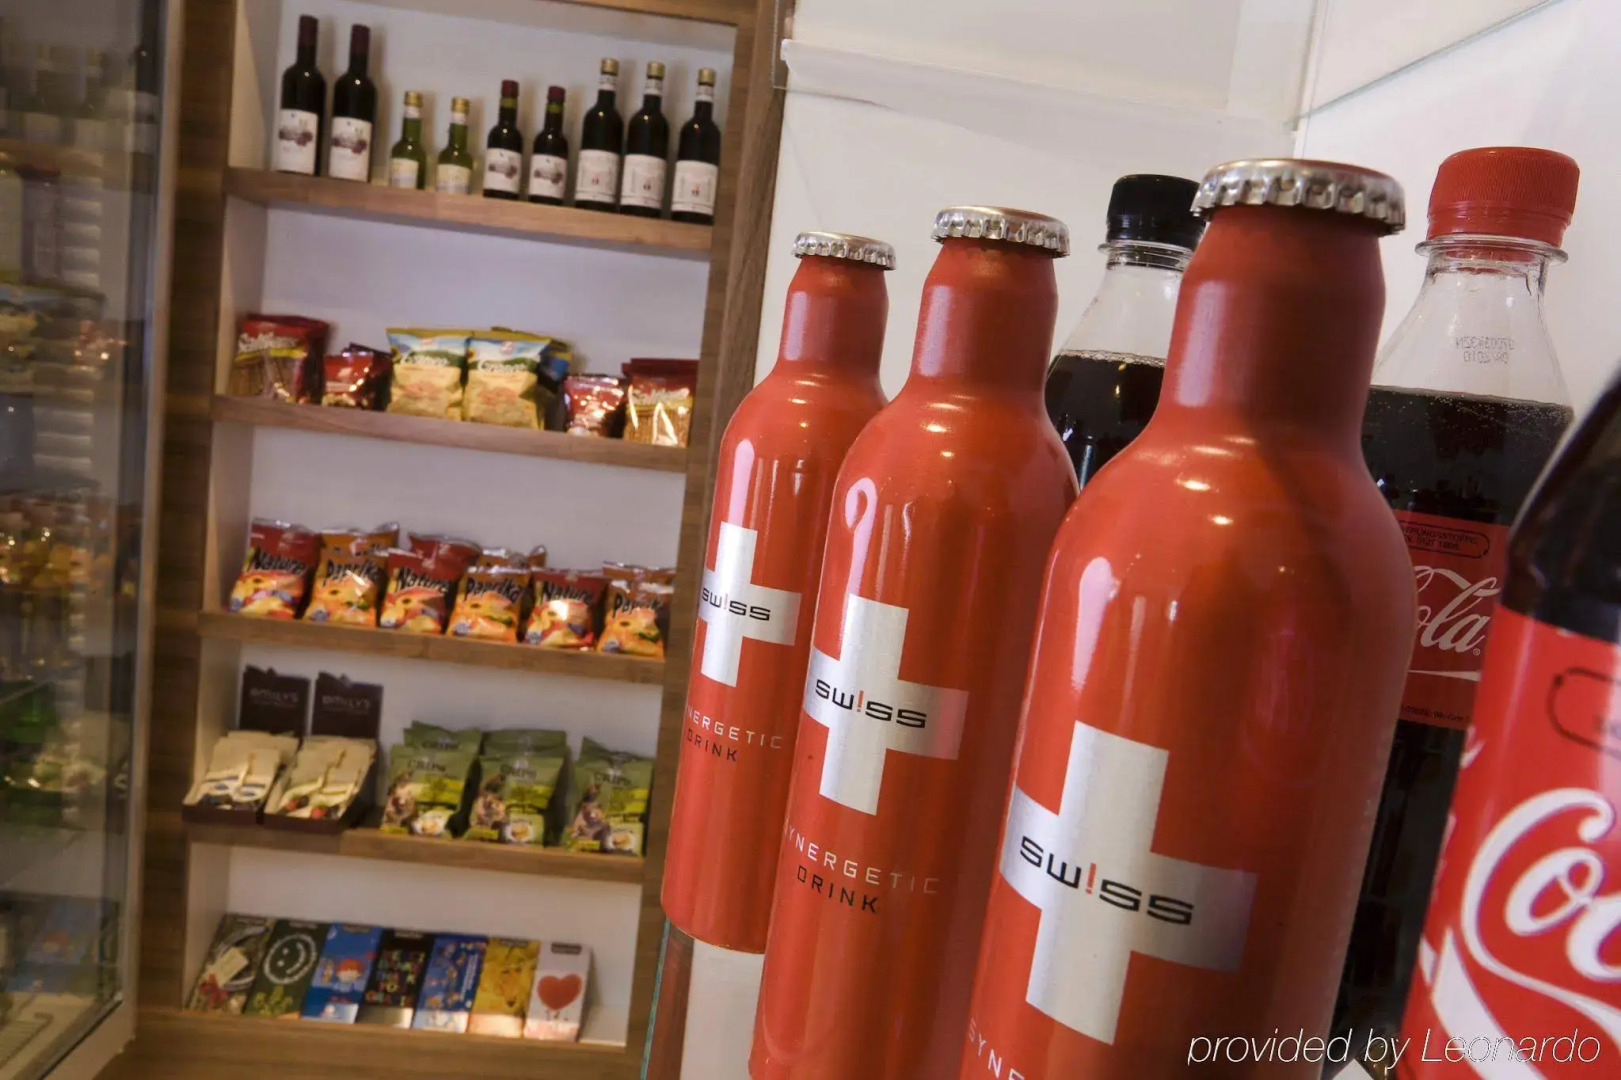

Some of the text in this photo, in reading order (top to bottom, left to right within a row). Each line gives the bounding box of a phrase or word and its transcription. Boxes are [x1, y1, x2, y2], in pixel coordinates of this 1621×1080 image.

[465, 576, 522, 603] Paprika
[686, 704, 783, 749] NERGETIC
[686, 728, 738, 762] DRINK
[797, 865, 879, 914] DRINK
